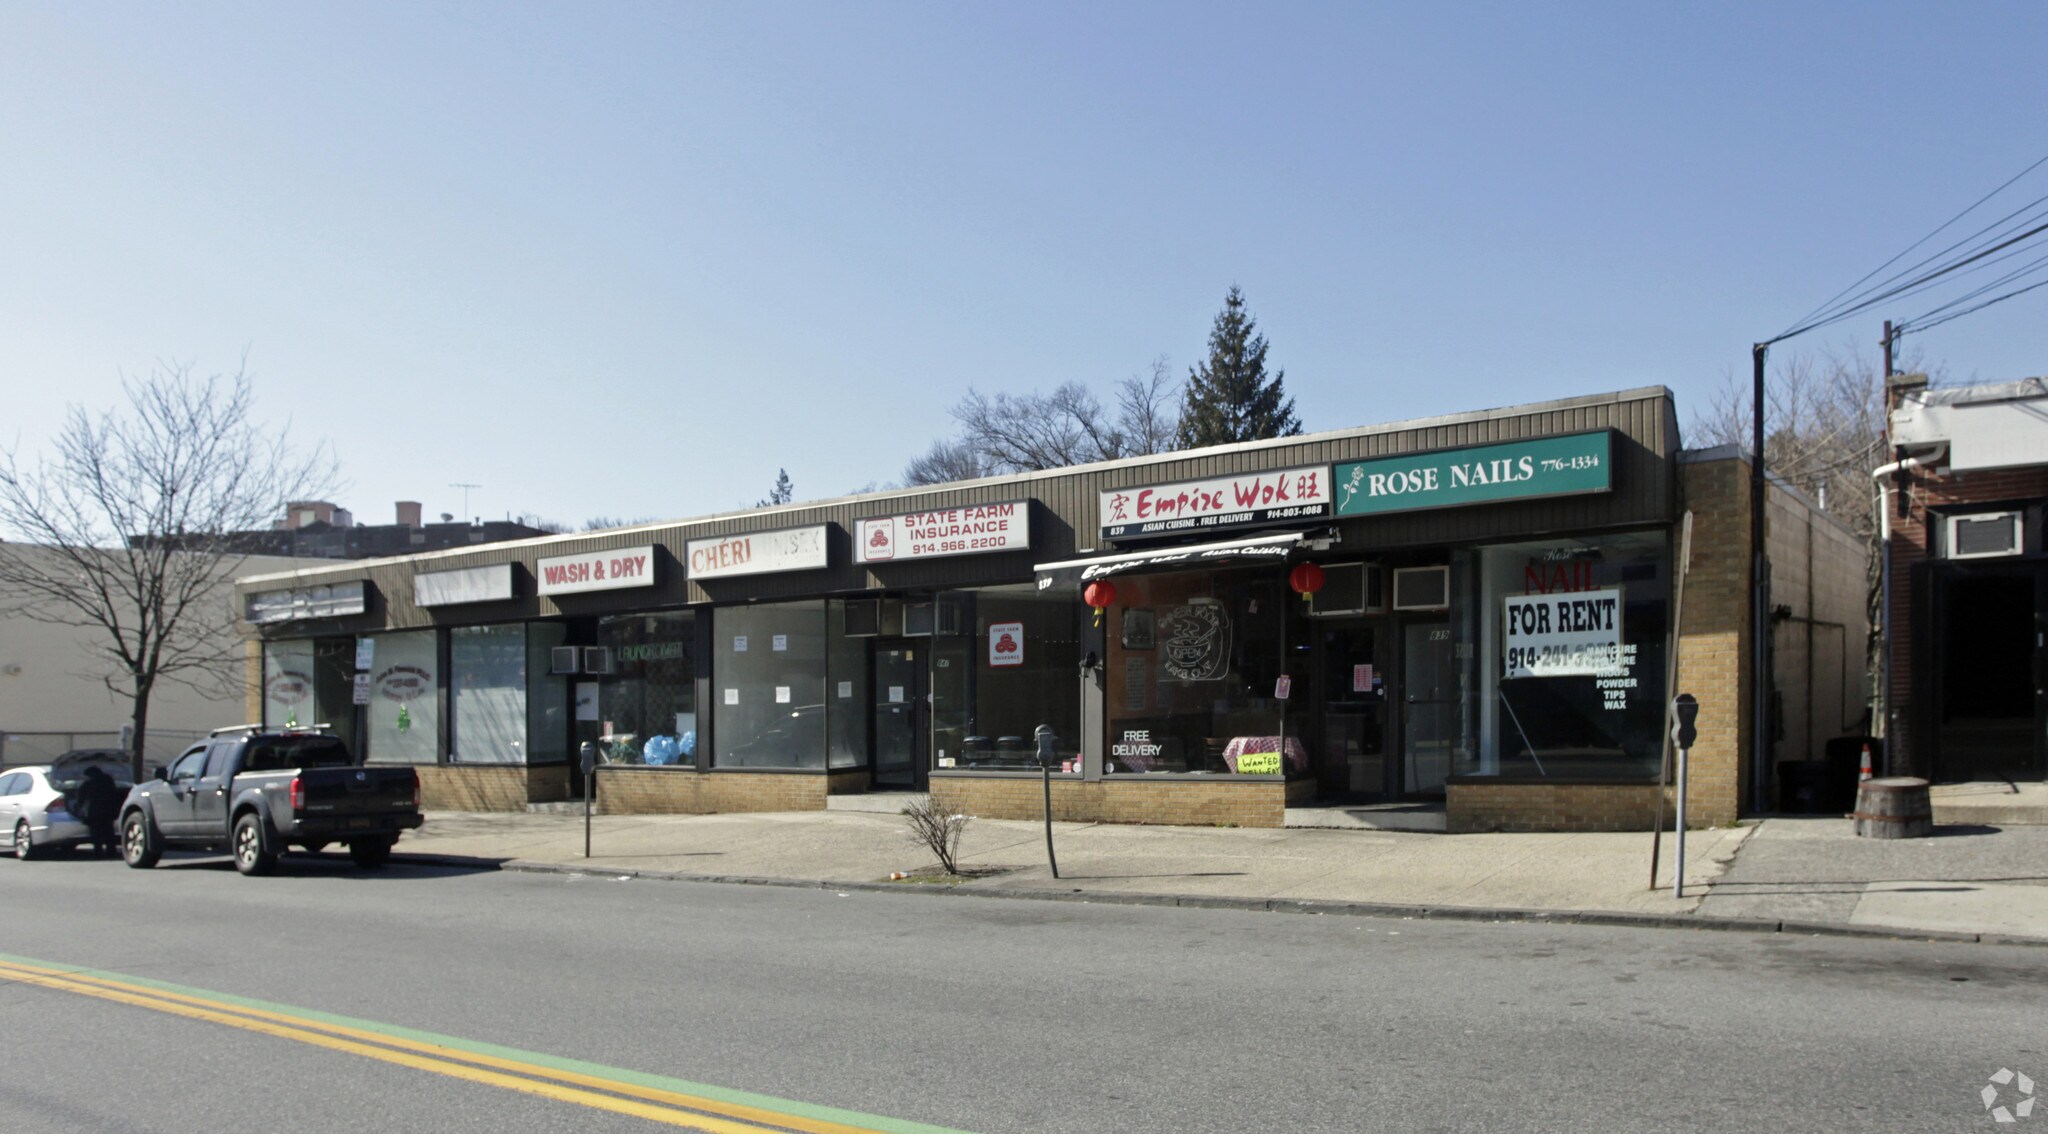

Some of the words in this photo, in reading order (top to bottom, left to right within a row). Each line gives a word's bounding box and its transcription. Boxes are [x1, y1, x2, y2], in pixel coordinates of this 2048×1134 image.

[1368, 467, 1439, 497] ROSE
[1450, 456, 1534, 489] NAILS
[1541, 453, 1600, 472] 776-1334
[1297, 472, 1321, 500] 旺
[1137, 487, 1224, 518] Empire
[1234, 473, 1290, 509] Wok
[905, 511, 957, 528] STATE
[965, 504, 1014, 521] FARM
[1267, 505, 1322, 519] 914-803-1088
[910, 520, 1008, 540] INSURANCE
[1110, 526, 1125, 536] 839
[1142, 521, 1165, 532] ASIAN
[1166, 519, 1196, 529] CUISINE
[1201, 516, 1218, 526] FREE
[1219, 512, 1254, 524] DELIVERY
[913, 536, 1006, 554] 914.966.2200
[544, 562, 590, 585] WASH
[594, 559, 605, 580] &
[610, 556, 646, 578] DRY
[1509, 603, 1551, 635] FOR
[1557, 598, 1616, 633] RENT
[617, 641, 683, 662] LAUNDROMAT
[1174, 648, 1200, 659] OPEN
[1596, 678, 1637, 689] POWDER
[1603, 690, 1626, 699] TIPS
[1604, 700, 1626, 710] WAX
[1124, 730, 1149, 742] FREE
[1112, 744, 1162, 756] DELIVERY
[1242, 757, 1278, 767] WANTED
